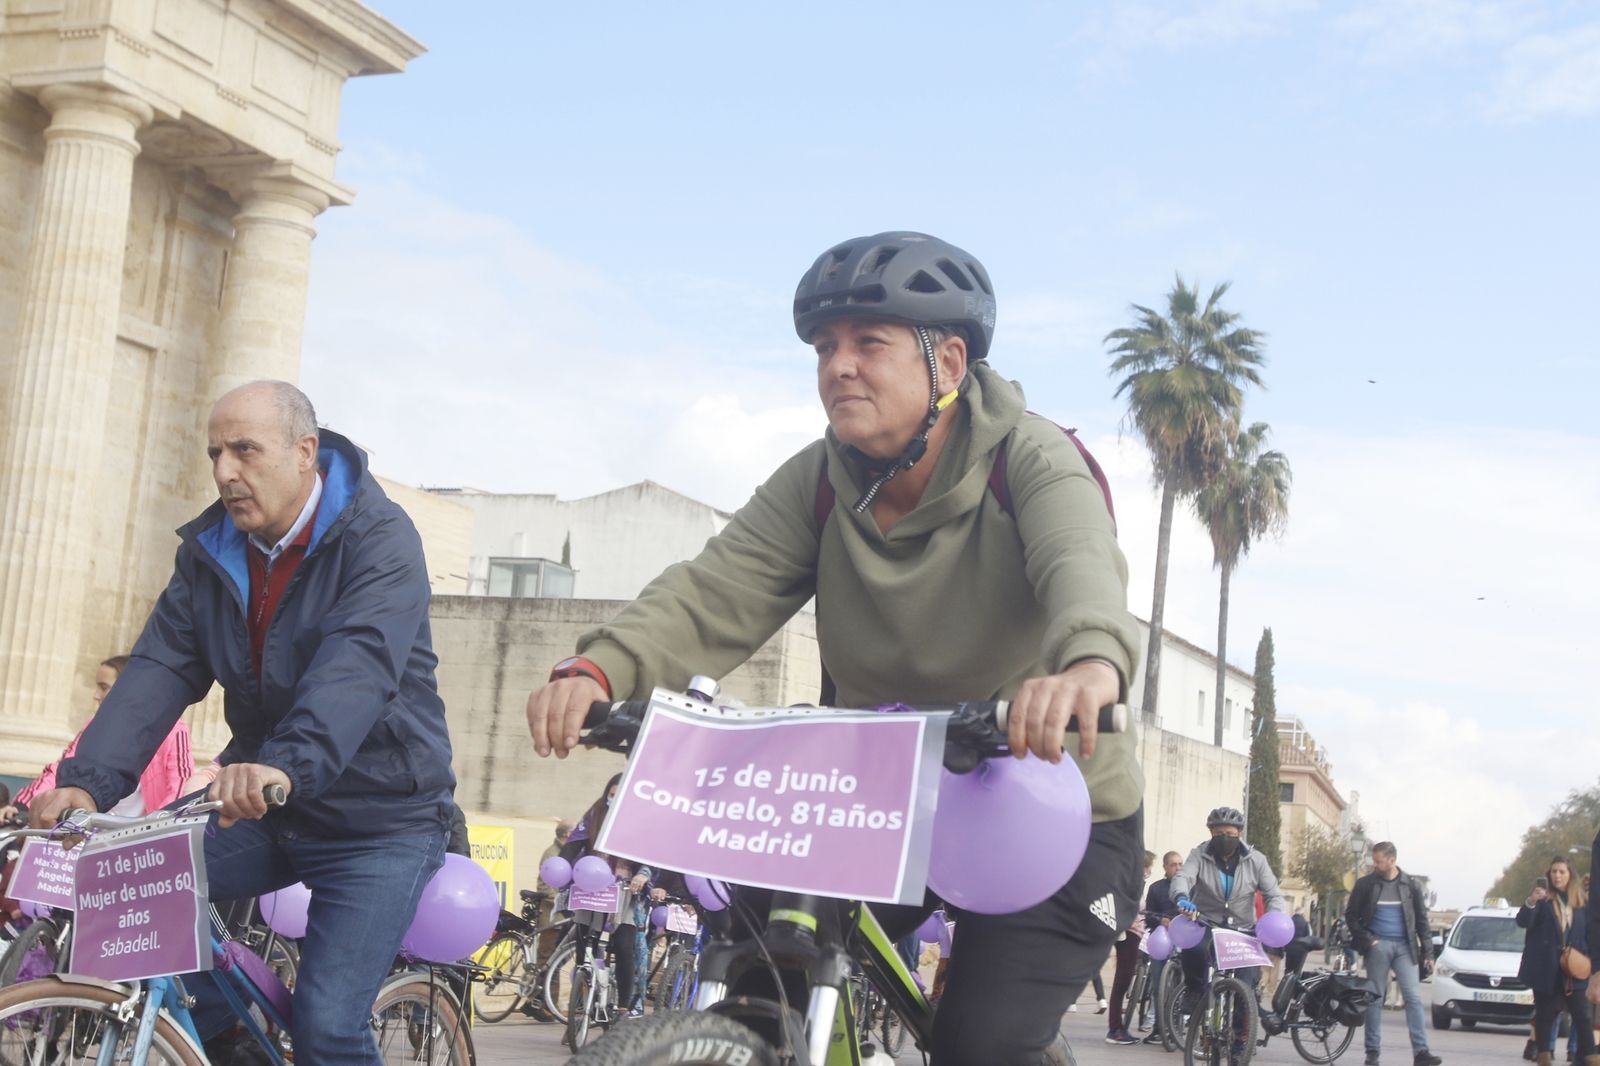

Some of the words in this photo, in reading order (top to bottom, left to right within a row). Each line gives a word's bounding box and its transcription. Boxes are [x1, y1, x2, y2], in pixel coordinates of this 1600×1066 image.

[694, 766, 728, 788] 15
[733, 762, 773, 789] de
[774, 764, 858, 795] junio
[632, 779, 782, 828] Consuelo,
[790, 801, 903, 831] 81años
[53, 848, 66, 859] de
[66, 850, 80, 861] jul
[471, 842, 508, 860] TRUCCIÓN
[697, 826, 813, 858] Madrid
[60, 862, 74, 873] de
[96, 859, 112, 879] 21
[114, 855, 131, 875] de
[133, 848, 165, 875] julio
[37, 881, 73, 897] Madrid
[79, 889, 117, 911] Mujer
[120, 882, 137, 903] de
[139, 879, 173, 899] unos
[174, 872, 192, 892] 60
[118, 908, 151, 929] años
[100, 930, 161, 958] Sabadell.
